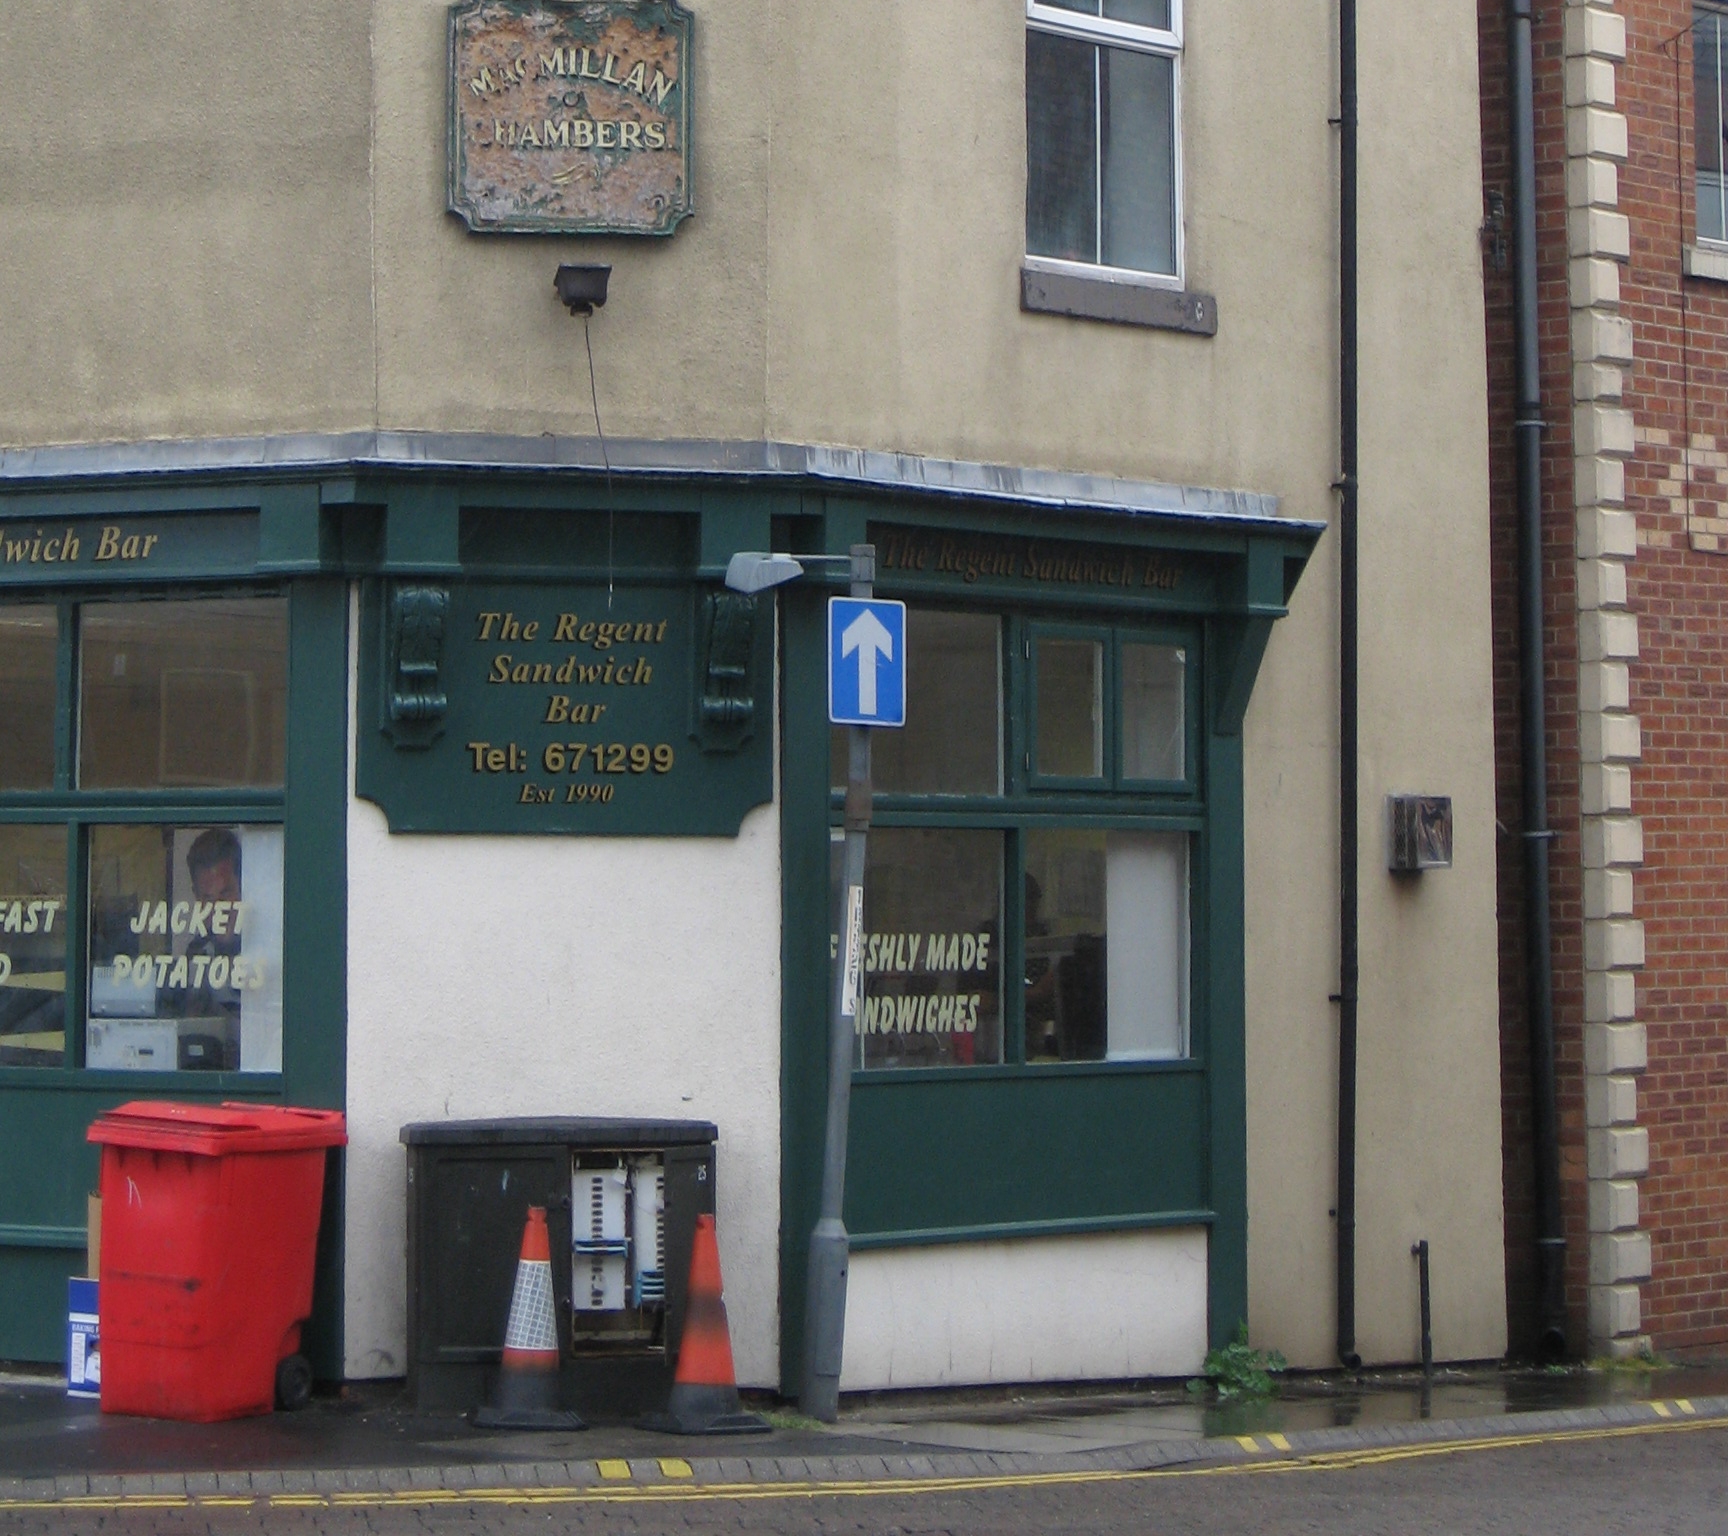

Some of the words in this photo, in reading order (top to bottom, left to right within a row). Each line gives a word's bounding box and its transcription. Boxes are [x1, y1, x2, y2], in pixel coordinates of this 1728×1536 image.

[95, 526, 158, 559] Bar
[883, 535, 928, 569] The
[936, 538, 1017, 583] Regent
[1023, 545, 1134, 587] Sandwich
[1143, 555, 1183, 589] Bar
[477, 612, 539, 642] The
[553, 613, 667, 649] Regent
[489, 655, 653, 684] Sandwich
[545, 694, 607, 724] Bar
[468, 742, 527, 772] Tel:
[544, 742, 675, 773] 671299
[519, 783, 555, 804] Est
[565, 783, 614, 804] 1990
[130, 900, 246, 936] JACKET
[926, 933, 990, 971] MADE
[112, 953, 266, 989] POTATOES
